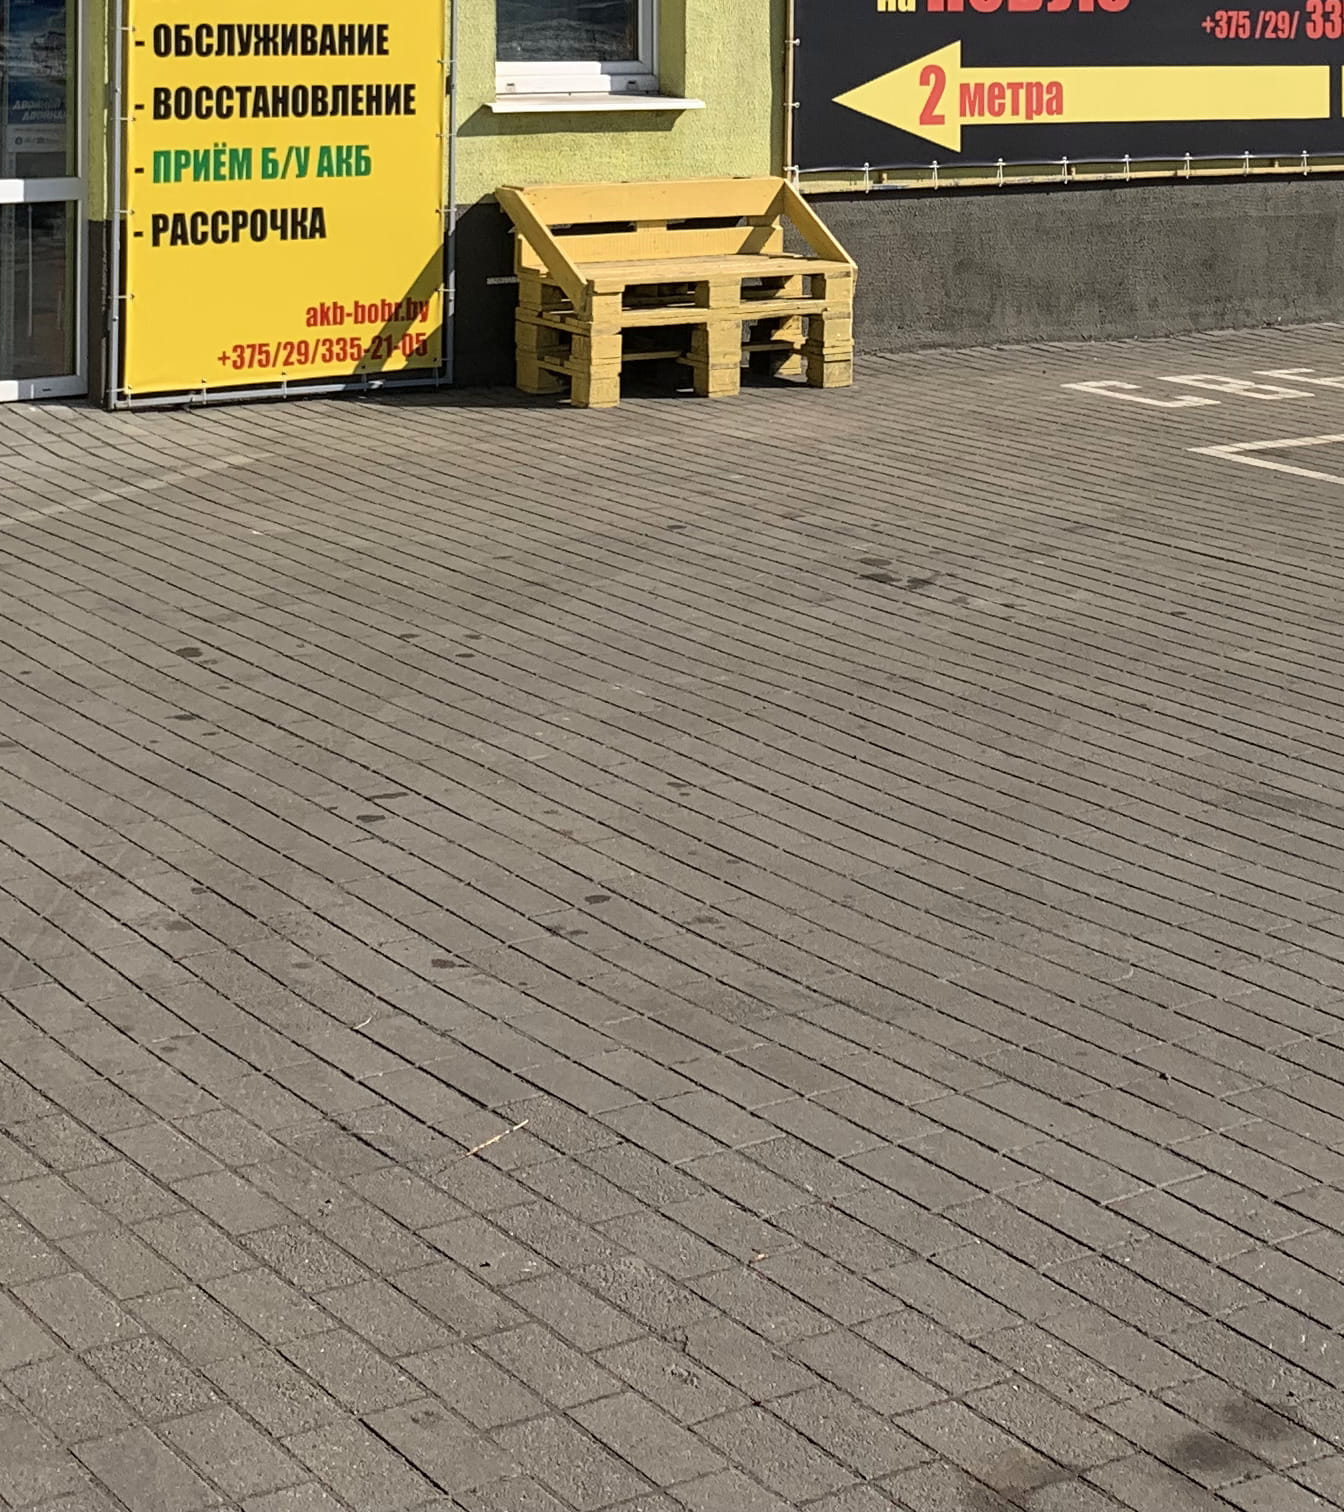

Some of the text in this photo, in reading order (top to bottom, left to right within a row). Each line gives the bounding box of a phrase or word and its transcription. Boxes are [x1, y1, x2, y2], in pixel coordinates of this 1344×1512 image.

[152, 22, 389, 59] ОБСЛУЖИВАНИЕ
[1200, 10, 1251, 39] +375
[1255, 10, 1300, 39] /29/
[152, 82, 417, 121] ВОССТАНОВЛЕНИЕ
[919, 64, 1064, 126] 2 метра
[152, 143, 373, 185] ПРИЁМ Б/У АКБ
[152, 206, 327, 247] РАССРОЧКА
[306, 298, 430, 327] akb-bobr.by
[217, 333, 428, 370] +375/29/335-21-05
